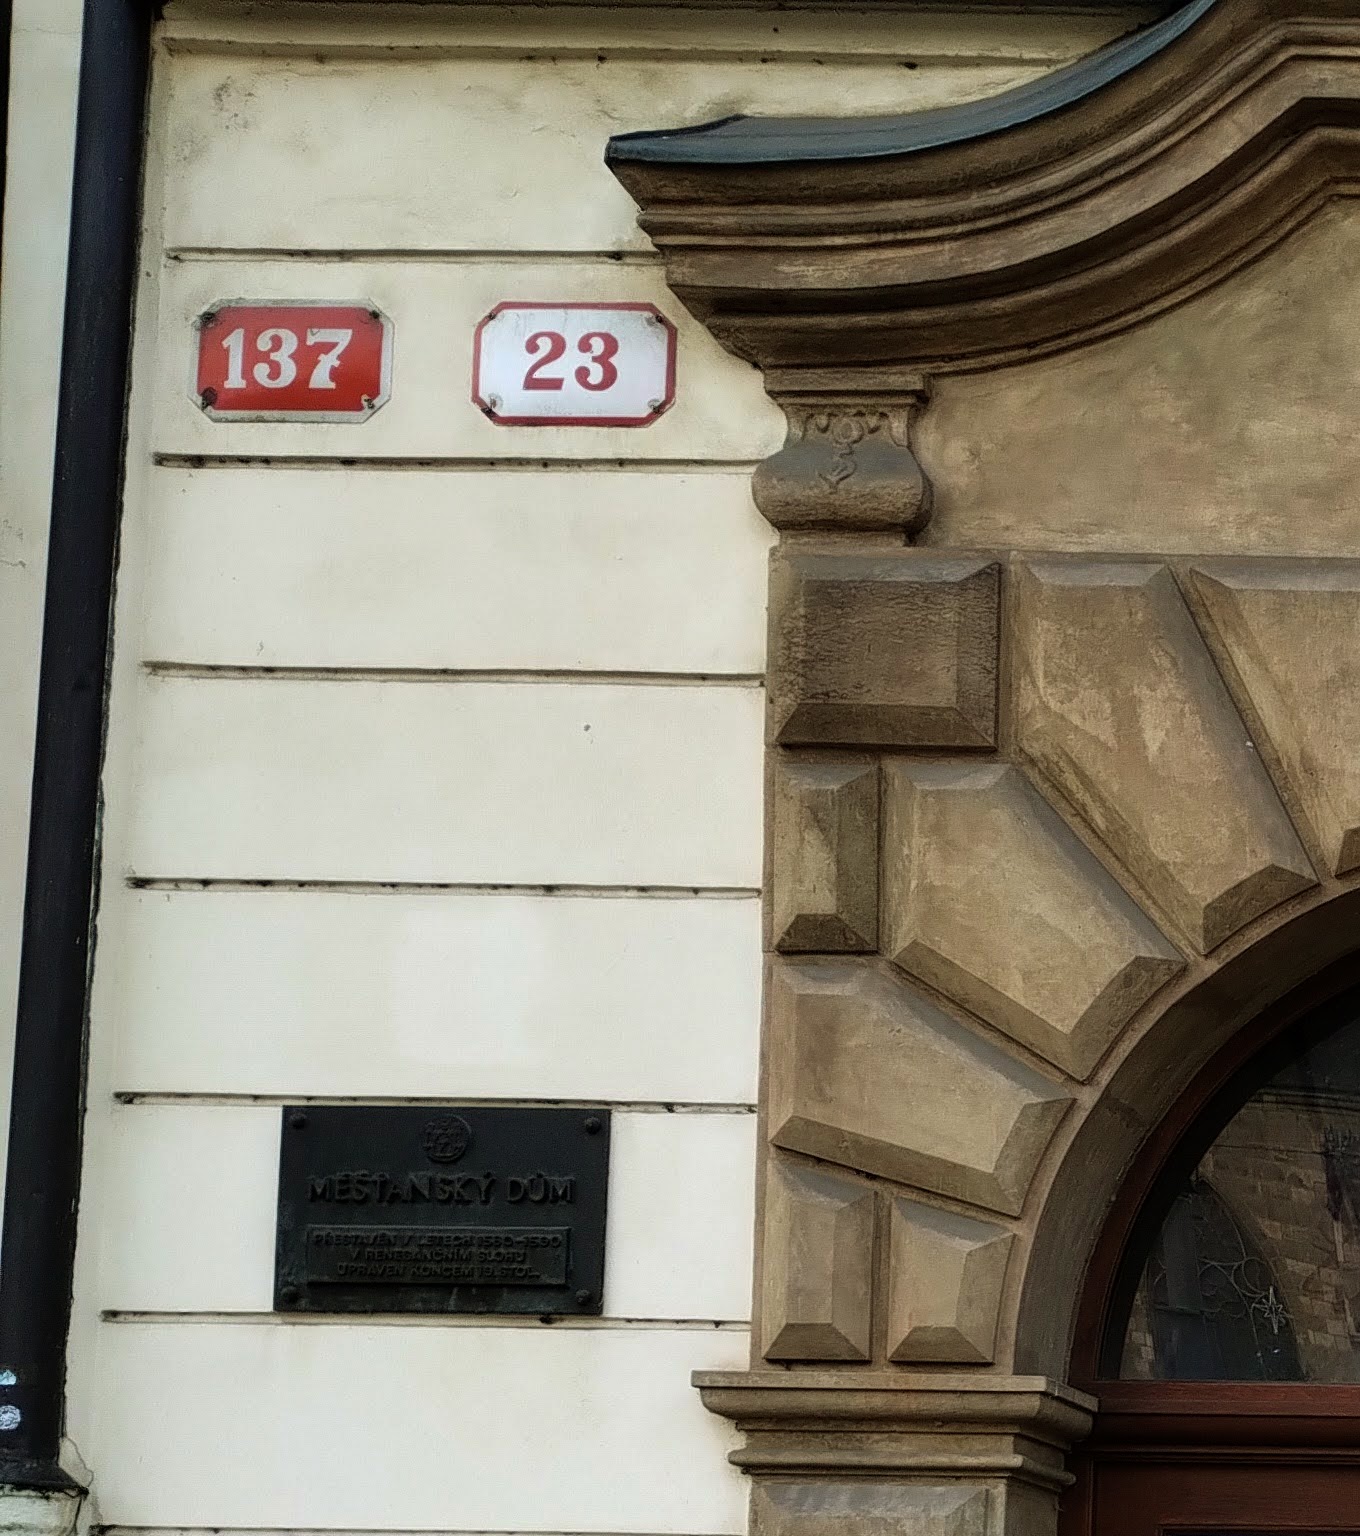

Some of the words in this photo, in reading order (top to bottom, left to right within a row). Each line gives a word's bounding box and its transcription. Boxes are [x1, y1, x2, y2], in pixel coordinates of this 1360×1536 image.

[222, 329, 352, 389] 137
[522, 332, 619, 391] 23
[506, 1171, 575, 1202] DŮM
